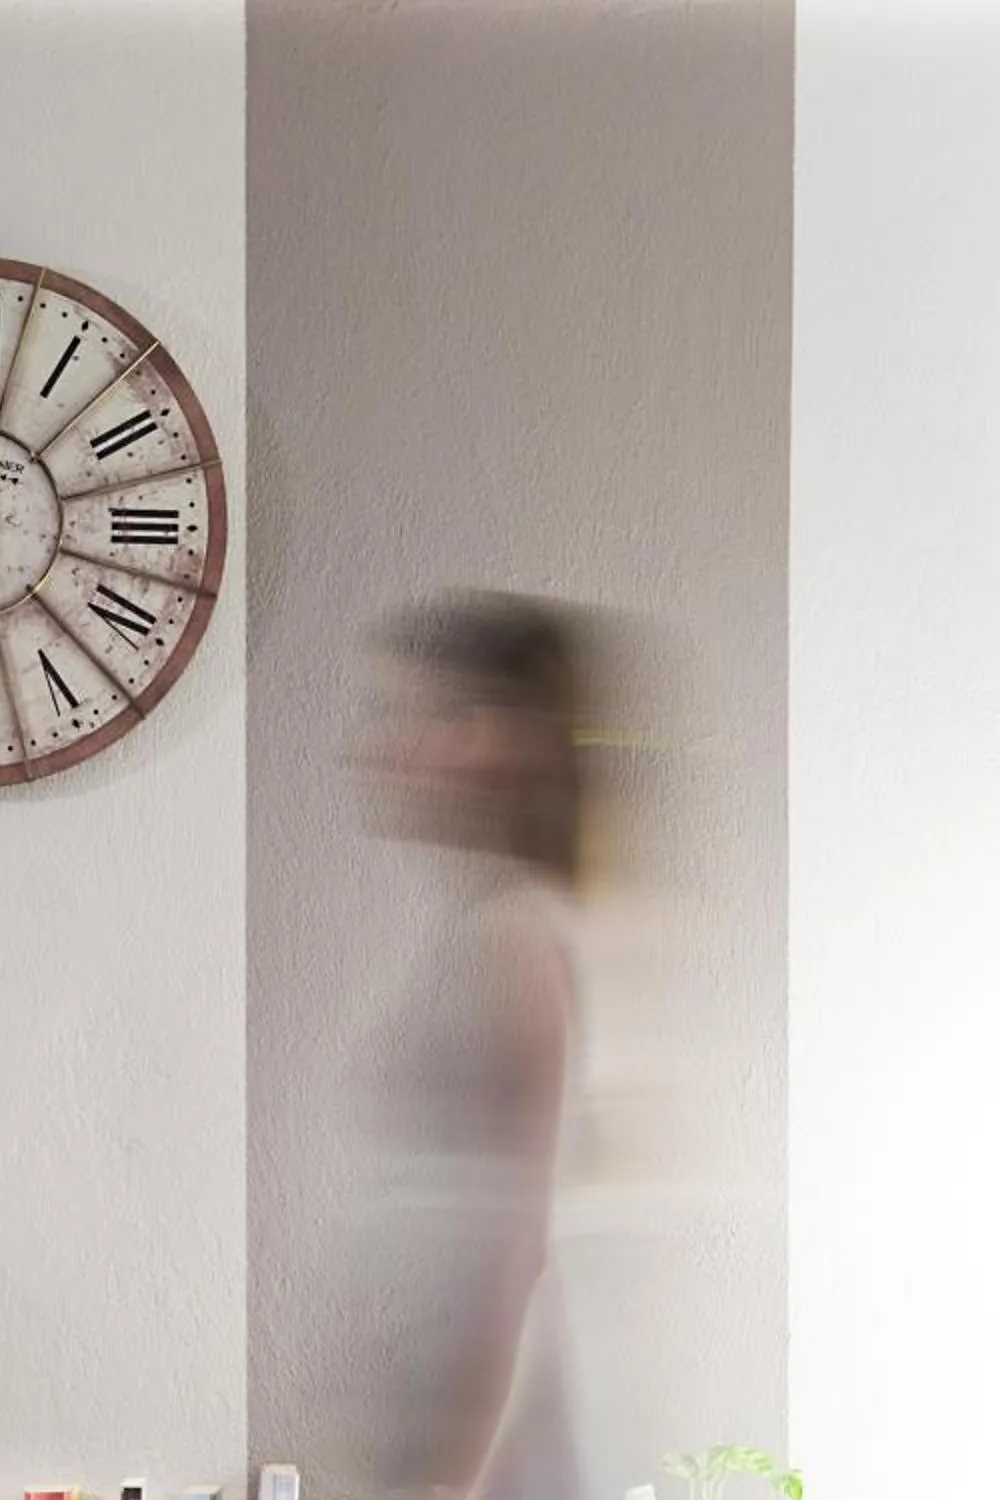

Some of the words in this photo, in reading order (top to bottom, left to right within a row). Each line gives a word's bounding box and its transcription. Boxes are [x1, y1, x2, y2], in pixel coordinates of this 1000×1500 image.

[89, 409, 158, 460] II
[109, 508, 180, 544] III
[37, 648, 80, 717] V
